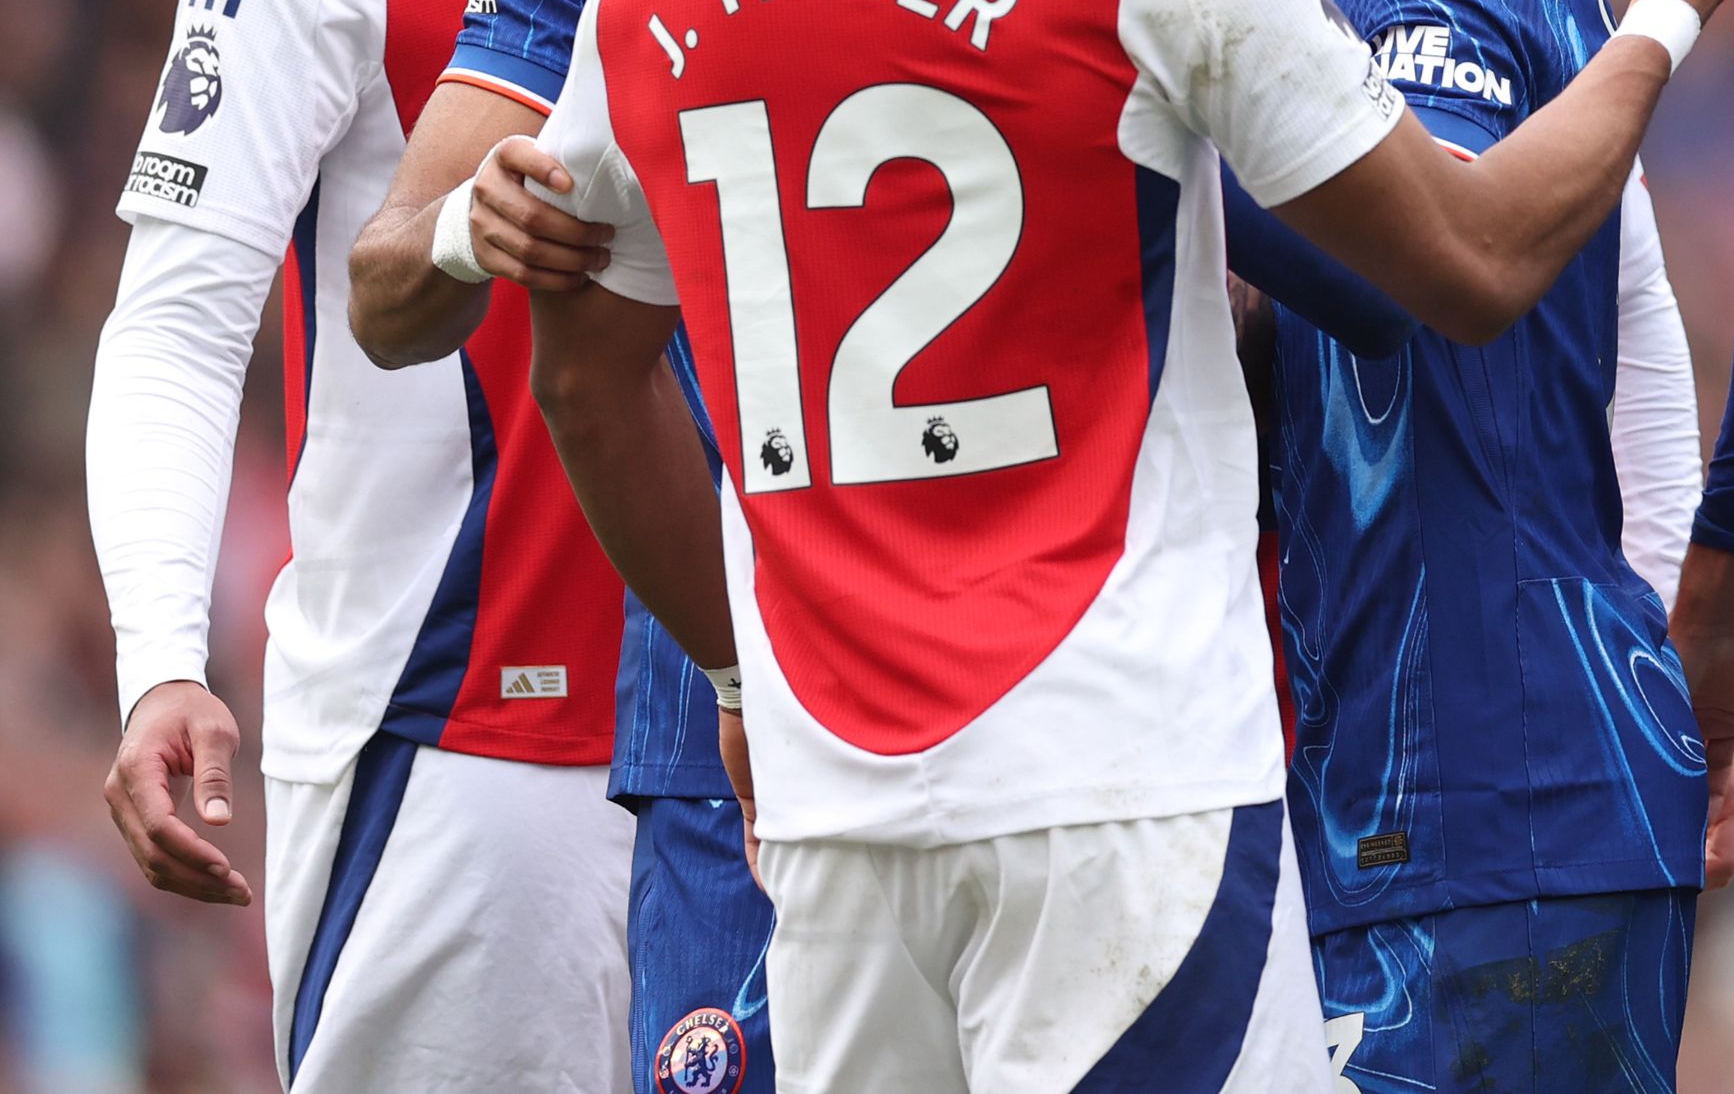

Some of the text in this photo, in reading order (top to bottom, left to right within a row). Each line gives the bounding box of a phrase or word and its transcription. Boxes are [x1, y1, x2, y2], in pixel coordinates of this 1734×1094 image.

[648, 12, 698, 79] J.
[1371, 25, 1450, 57] IVE
[141, 156, 195, 186] room
[132, 175, 199, 208] racism
[677, 82, 1060, 494] 12
[676, 1013, 730, 1036] CHELSEA
